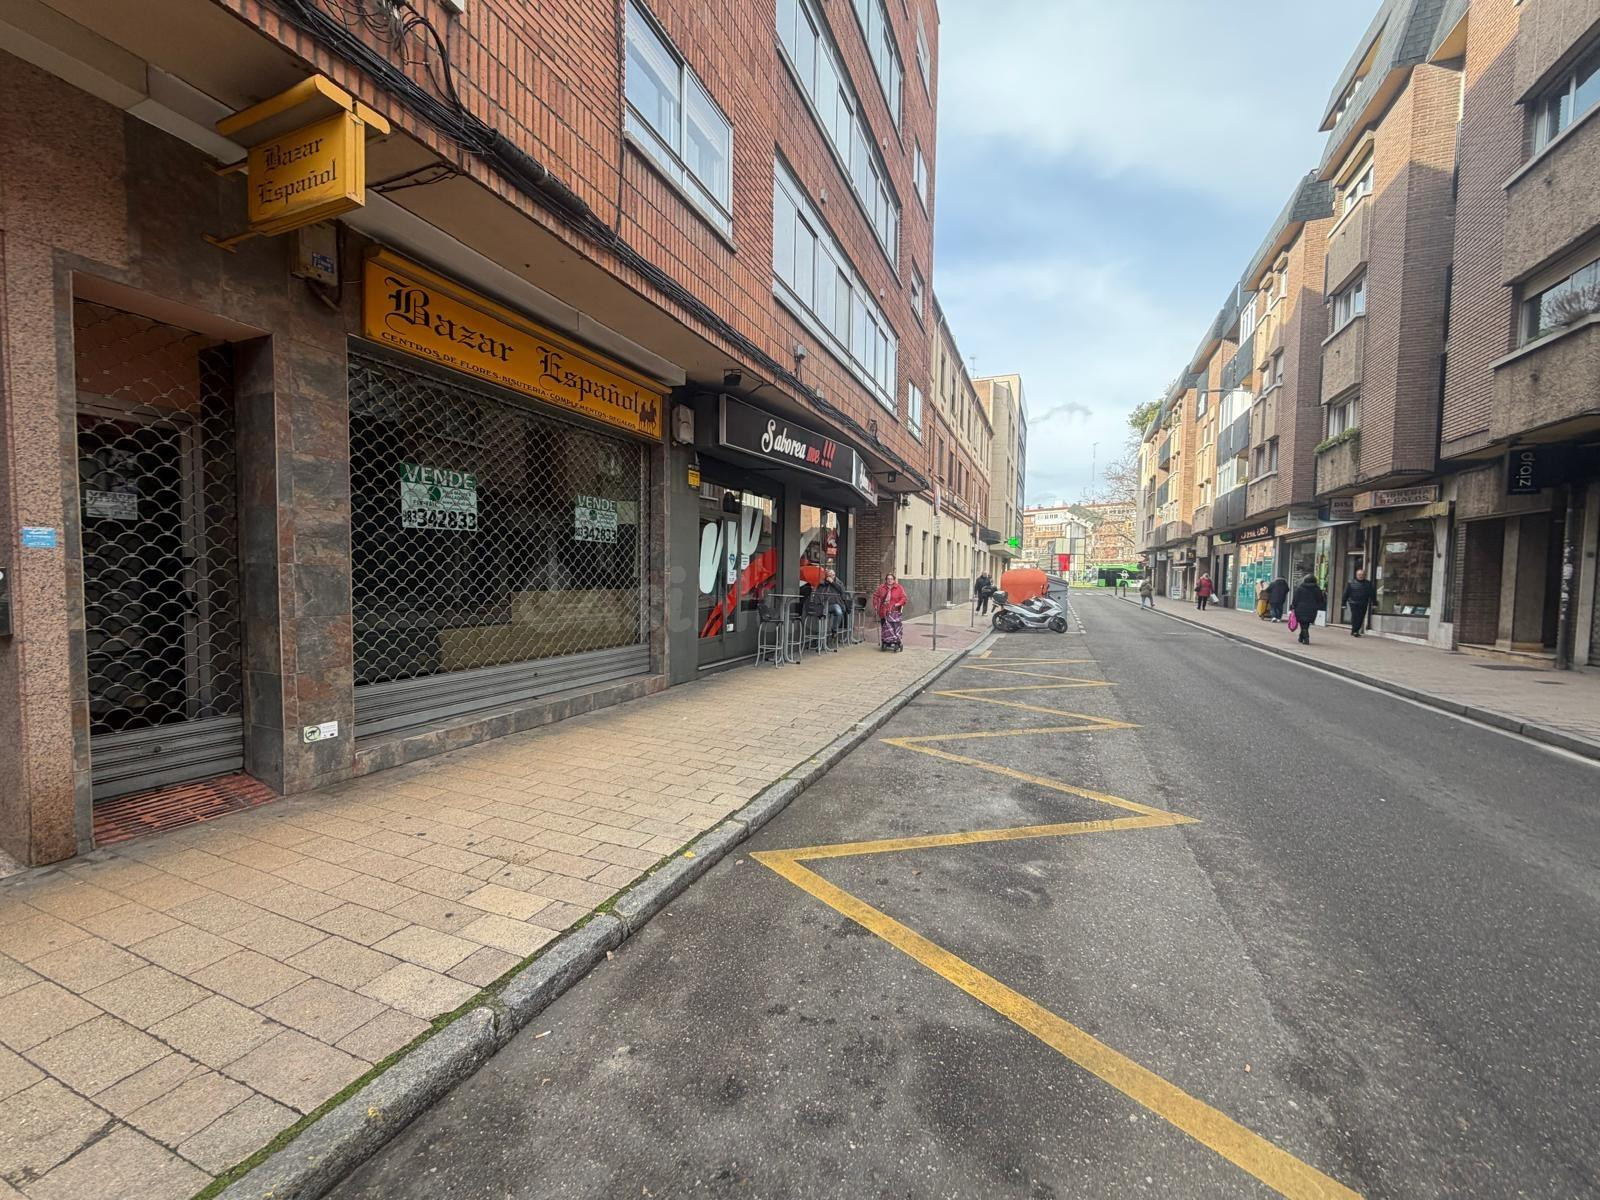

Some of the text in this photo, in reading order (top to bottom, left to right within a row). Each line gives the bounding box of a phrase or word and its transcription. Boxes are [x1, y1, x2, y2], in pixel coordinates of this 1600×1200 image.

[263, 137, 323, 171] Bazar
[257, 158, 337, 207] Español
[381, 331, 442, 360] CENTROS
[443, 353, 457, 363] DE
[384, 276, 639, 414] Bazar Español
[761, 418, 806, 461] Saborea
[404, 464, 475, 489] VENDE
[577, 495, 616, 511] VENDE
